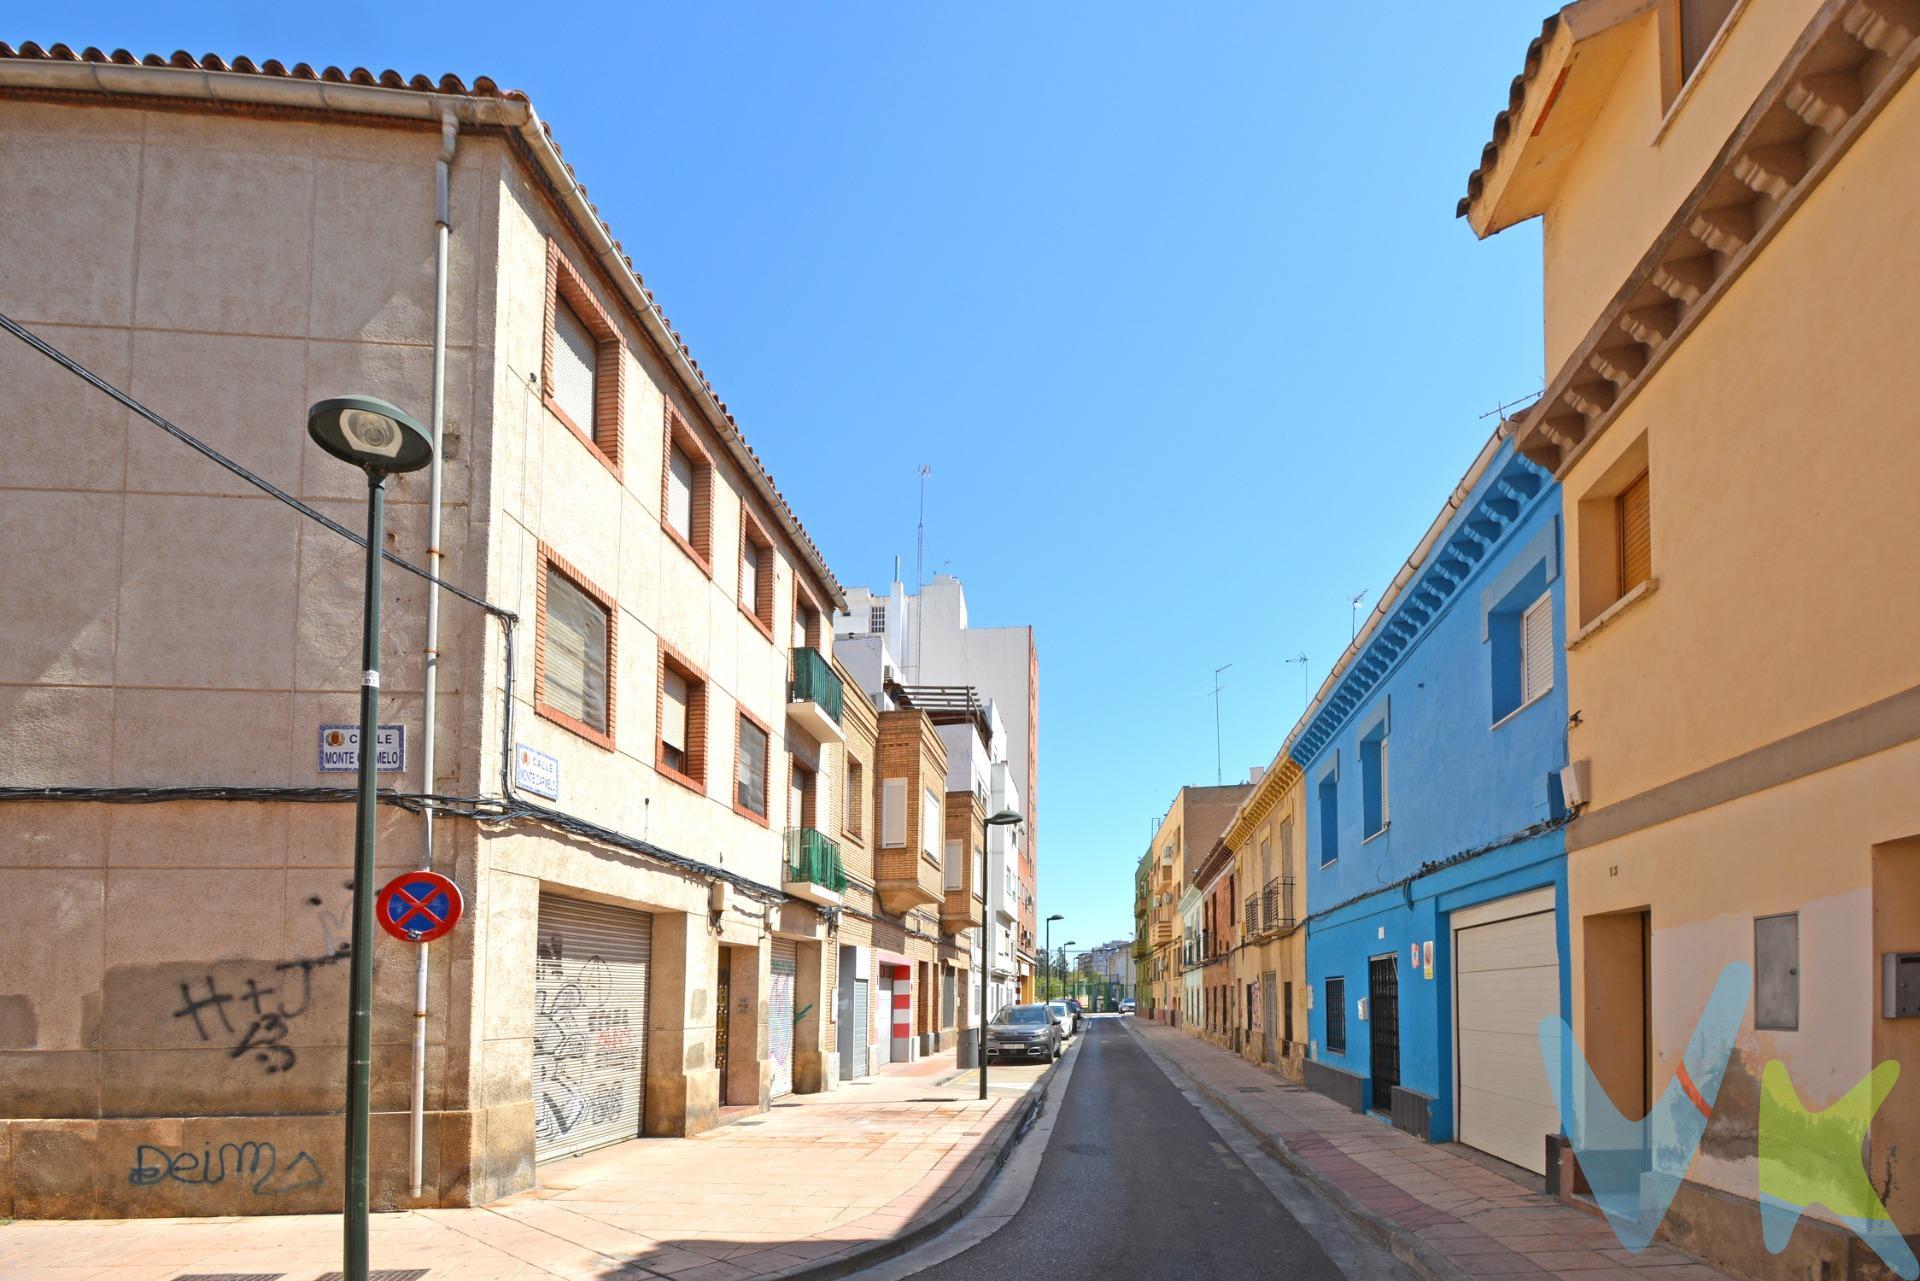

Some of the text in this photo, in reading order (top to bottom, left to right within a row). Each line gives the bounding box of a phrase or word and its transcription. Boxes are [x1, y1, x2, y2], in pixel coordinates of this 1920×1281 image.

[349, 734, 393, 744] CLE
[324, 751, 399, 764] MONTE MELO
[532, 757, 553, 773] CALLE
